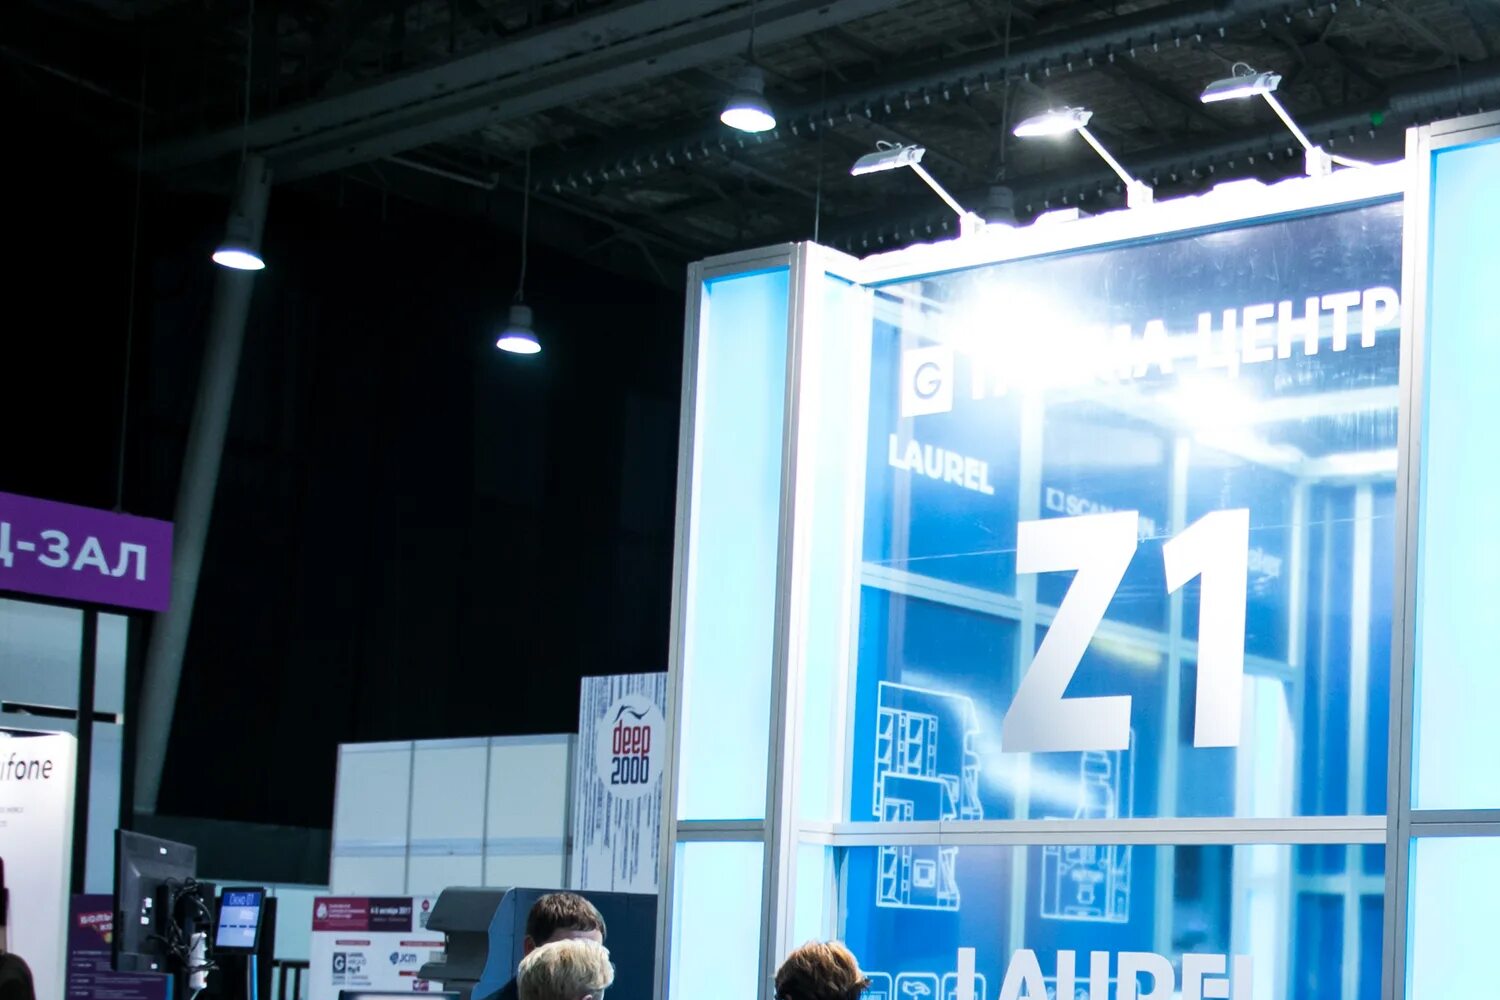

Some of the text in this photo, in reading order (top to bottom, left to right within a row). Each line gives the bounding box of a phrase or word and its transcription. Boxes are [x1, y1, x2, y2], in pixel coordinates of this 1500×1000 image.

[1199, 286, 1399, 381] ЦЕНТР
[889, 434, 994, 495] LAUREL
[1001, 508, 1250, 753] Z1
[613, 719, 651, 757] deep
[611, 756, 649, 784] 2000
